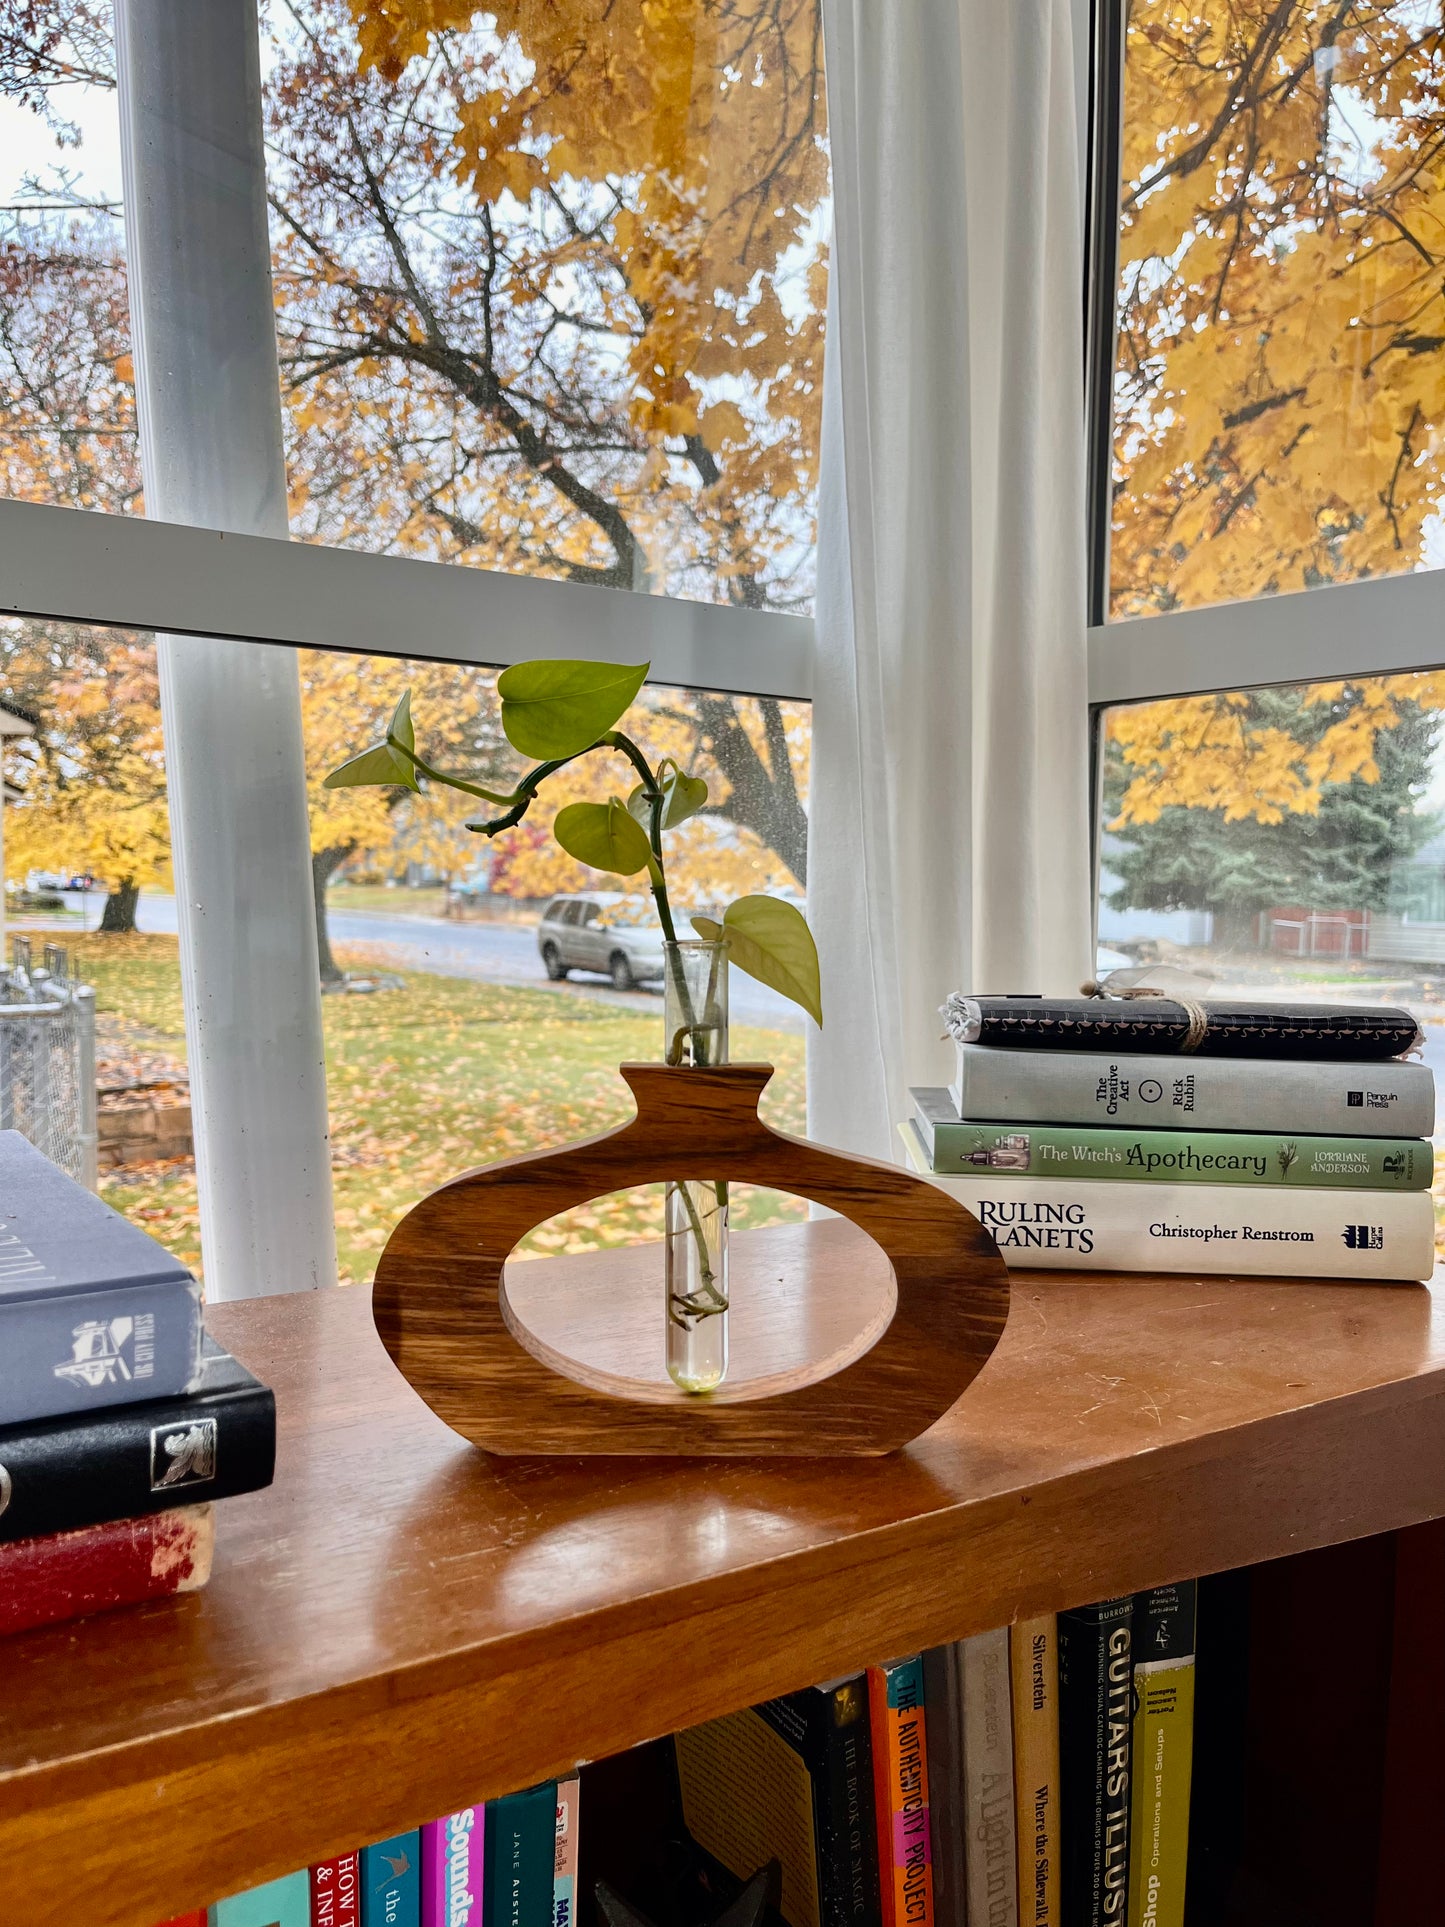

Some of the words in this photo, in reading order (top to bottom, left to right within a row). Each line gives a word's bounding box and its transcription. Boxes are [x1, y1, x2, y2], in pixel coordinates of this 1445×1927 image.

[1096, 1077, 1107, 1101] The
[1106, 1065, 1118, 1115] Creative
[1118, 1080, 1129, 1101] Act
[1172, 1079, 1183, 1106] Rick
[1183, 1074, 1194, 1112] Rubin
[1366, 1091, 1398, 1102] Penguin
[1366, 1100, 1389, 1108] Press
[1039, 1144, 1068, 1162] The
[1071, 1145, 1121, 1163] Witch's
[1126, 1143, 1267, 1176] Apothecary
[1310, 1162, 1370, 1174] ANDERSON
[1314, 1151, 1367, 1163] LORRIANE
[977, 1200, 1085, 1226] RULING
[990, 1225, 1094, 1254] LANETS
[1149, 1223, 1238, 1242] Christopher
[1242, 1226, 1314, 1242] Renstrom
[1368, 1226, 1377, 1248] Harper
[134, 1313, 154, 1341] PRESS
[134, 1343, 154, 1362] CITY
[1098, 1602, 1134, 1621] BURROWS
[1032, 1634, 1047, 1711] Silverstein
[897, 1679, 917, 1718] THE
[1096, 1685, 1104, 1713] VISUAL
[1147, 1688, 1176, 1697] Nelson
[1107, 1626, 1131, 1797] GUITARS
[1147, 1706, 1174, 1714] Porter
[1096, 1714, 1104, 1749] CATALOG
[844, 1737, 857, 1771] THE
[1154, 1728, 1165, 1771] Setups
[898, 1720, 923, 1835] AUTHENTICITY
[981, 1772, 1009, 1797] A
[1154, 1774, 1162, 1798] and
[846, 1776, 859, 1826] BOOK
[1034, 1785, 1049, 1830] Where
[850, 1830, 861, 1852] OF
[977, 1791, 1012, 1866] Light
[1151, 1801, 1161, 1867] Operations
[512, 1832, 521, 1869] JANE
[1034, 1832, 1049, 1857] the
[1094, 1840, 1101, 1849] OF
[450, 1808, 475, 1927] Sounds
[1093, 1851, 1101, 1871] OVER
[317, 1867, 333, 1884] &
[338, 1855, 355, 1910] HOW
[851, 1857, 865, 1914] MAGIC
[904, 1840, 926, 1925] PROJECT
[986, 1866, 1011, 1898] in
[1034, 1858, 1049, 1921] Sidewalk
[385, 1889, 400, 1923] the
[1092, 1890, 1100, 1901] OF
[988, 1896, 1012, 1927] th
